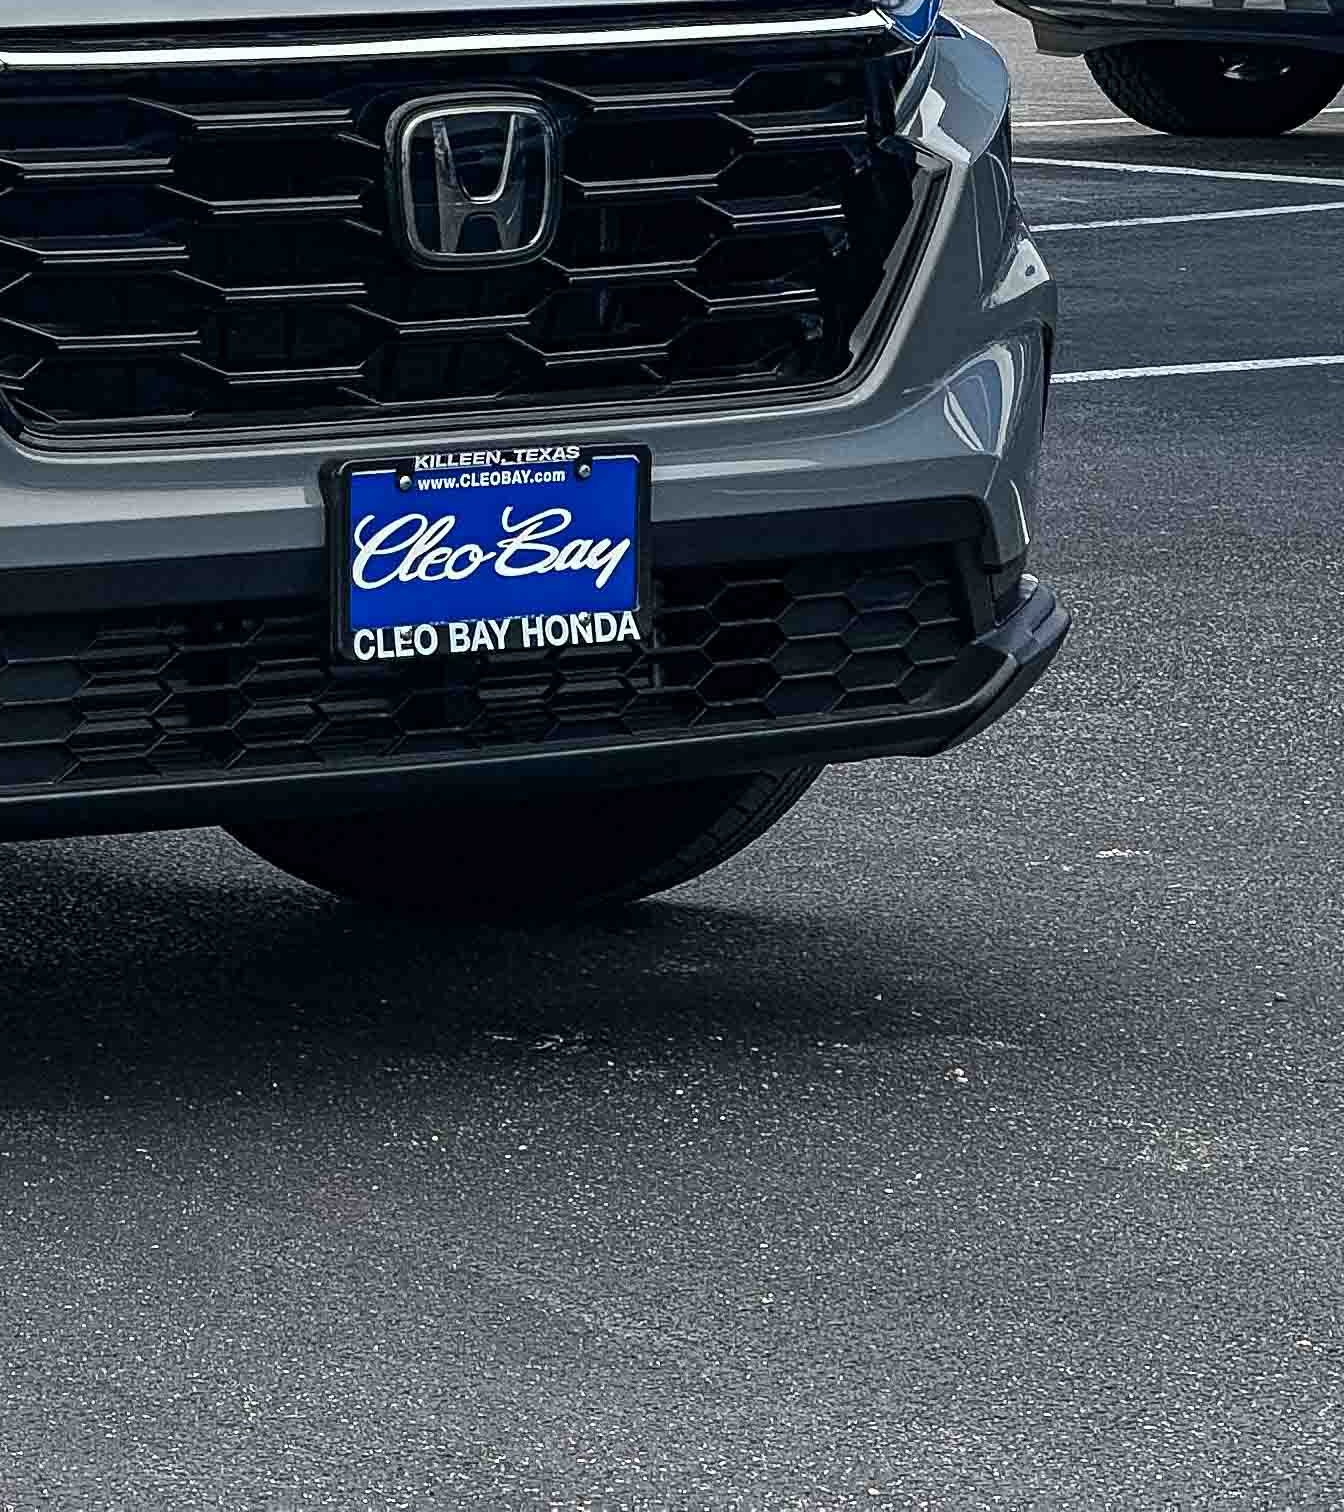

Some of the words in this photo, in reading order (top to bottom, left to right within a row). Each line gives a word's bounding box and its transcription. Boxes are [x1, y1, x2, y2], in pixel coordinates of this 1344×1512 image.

[414, 451, 506, 472] KILLEEN,
[513, 446, 580, 464] TEXAS
[417, 469, 566, 491] www.CLEOBAY.com
[352, 513, 496, 590] Cleo
[494, 505, 631, 589] Bay
[353, 624, 438, 661] CLEO
[449, 619, 512, 654] BAY
[522, 610, 641, 649] HONDA
